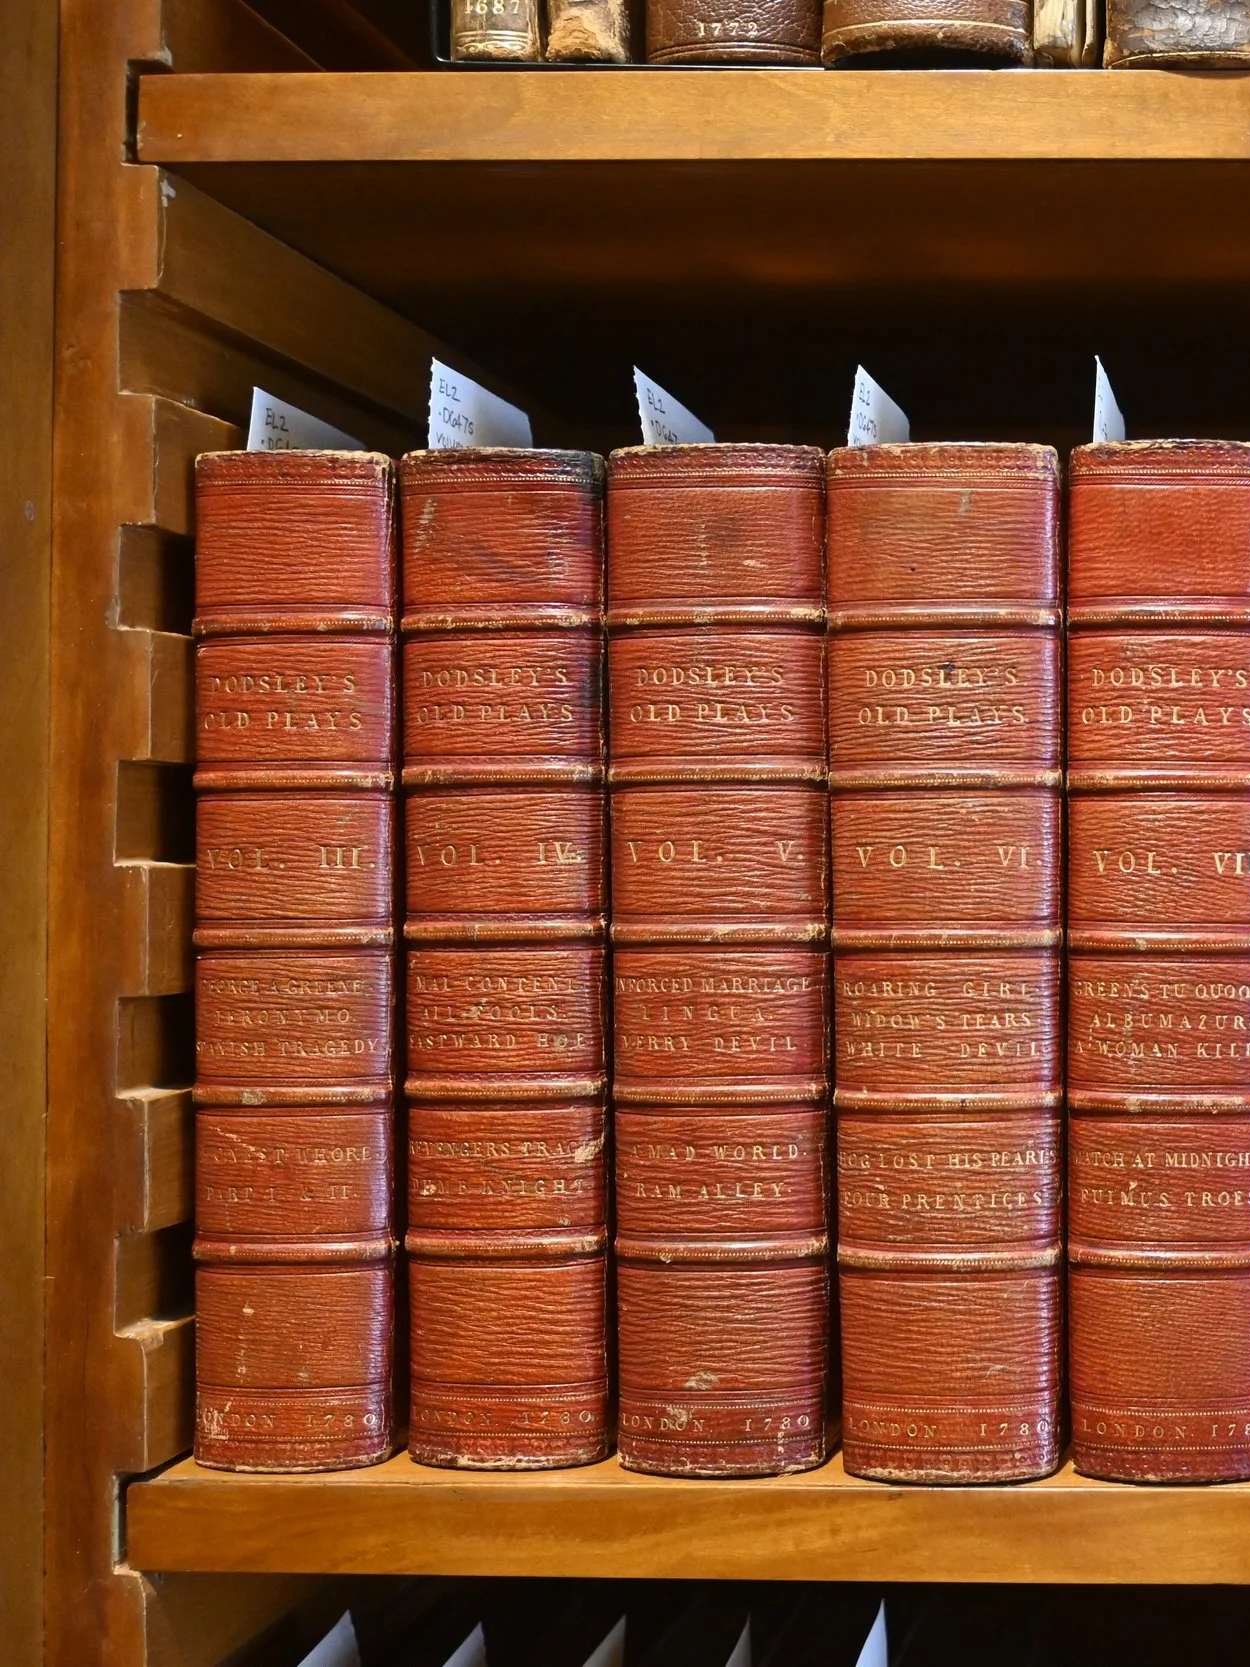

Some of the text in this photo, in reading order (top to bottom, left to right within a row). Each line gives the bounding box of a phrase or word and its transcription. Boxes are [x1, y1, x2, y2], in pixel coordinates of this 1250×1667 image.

[697, 22, 758, 36] 1772
[439, 378, 461, 402] EL2
[265, 408, 289, 432] EL2
[637, 667, 784, 687] DODSLEY'S
[865, 669, 1019, 688] DODSLEY'S
[1092, 668, 1248, 688] DODSLEY'S
[205, 711, 363, 729] OLD PLAYS
[417, 704, 574, 724] OLD PLAYS
[630, 703, 795, 723] OLD PLAYS
[858, 707, 909, 725] OLD
[1081, 706, 1133, 724] OLD
[207, 848, 285, 869] VOL.
[417, 845, 502, 866] VOL.
[628, 841, 804, 863] VOL. V.
[856, 846, 1043, 868] VOL. VI.
[1093, 850, 1178, 874] VOL.
[842, 981, 937, 997] ROARING
[1160, 983, 1186, 999] TU
[642, 1006, 774, 1021] LINGUA.
[850, 1012, 946, 1030] WIDOW'S
[846, 1041, 922, 1057] WHITE
[1099, 1041, 1179, 1058] WOMAN
[649, 1145, 695, 1160] MAD
[712, 1144, 807, 1161] WORLD.
[879, 1152, 935, 1169] LOST
[948, 1152, 982, 1168] HIS
[1132, 1152, 1156, 1168] AT
[636, 1182, 792, 1199] RAM ALLEY.
[1081, 1188, 1170, 1207] FUIMUS
[844, 1191, 1043, 1209] FOUR PRENTICES
[306, 1413, 376, 1428] 1780
[744, 1415, 811, 1432] 1780
